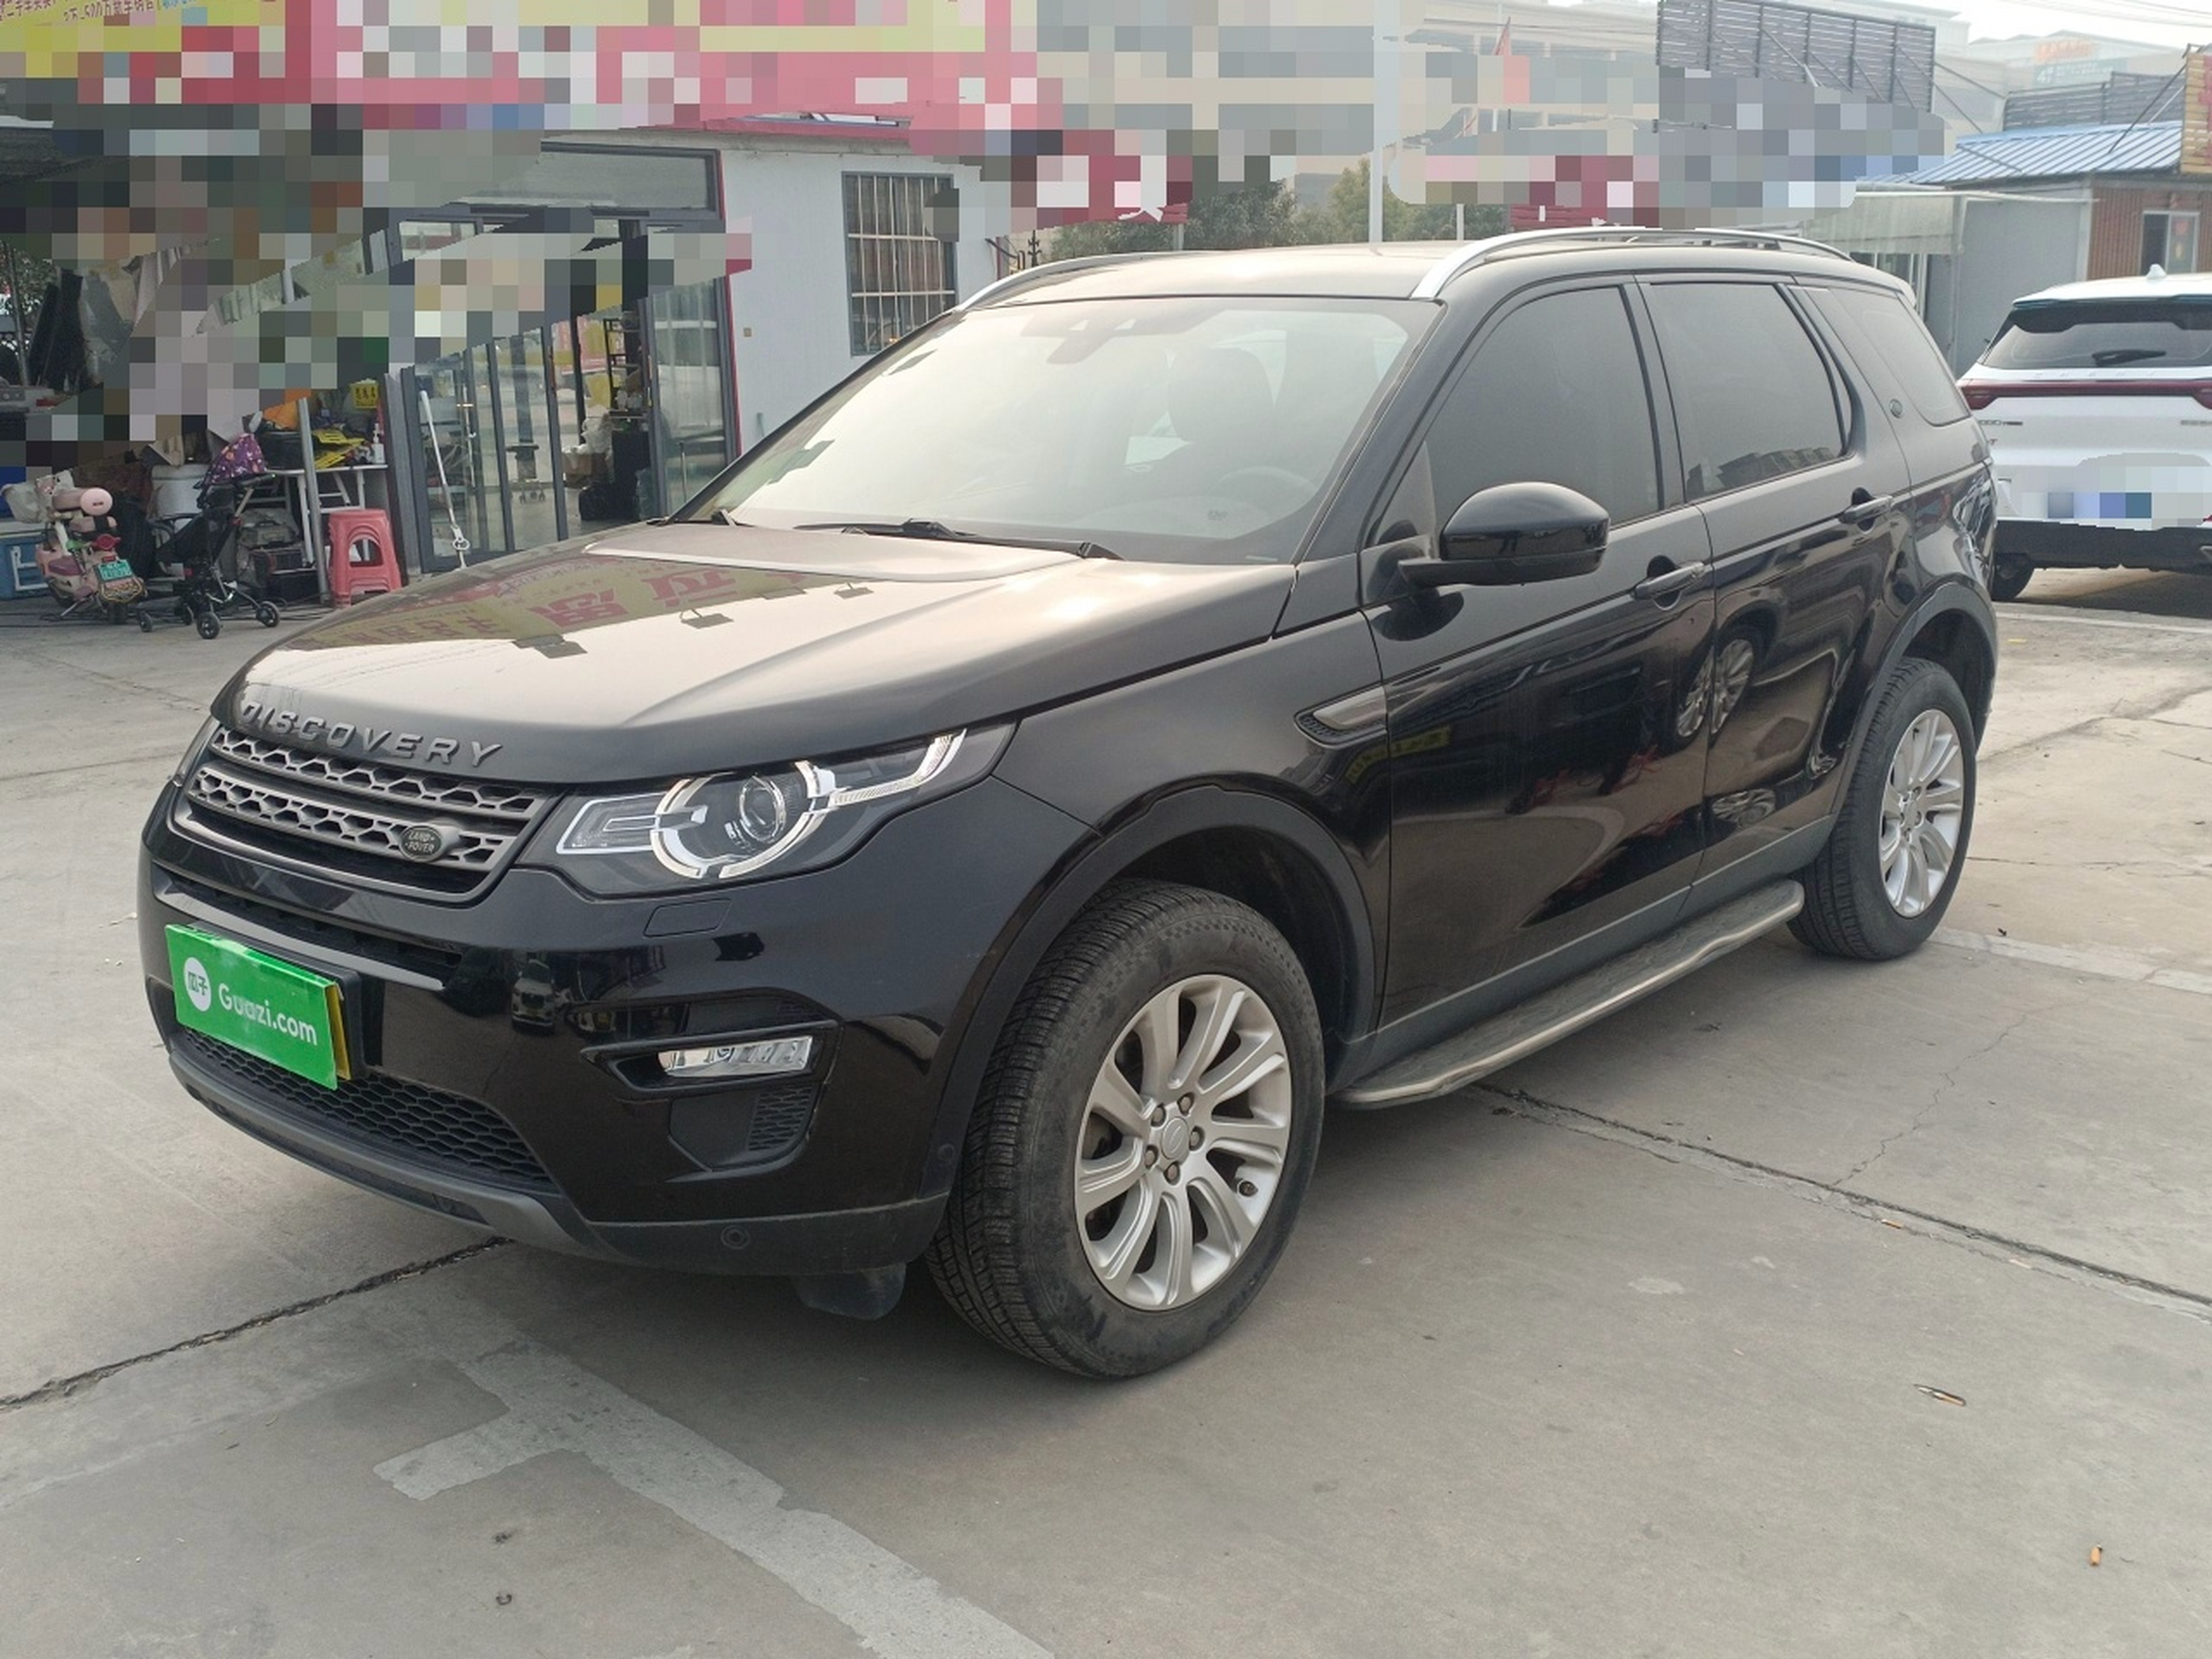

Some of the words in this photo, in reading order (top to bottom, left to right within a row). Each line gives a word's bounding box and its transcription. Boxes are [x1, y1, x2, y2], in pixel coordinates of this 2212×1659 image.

[240, 700, 503, 767] DISCOVERY
[407, 841, 434, 853] ROVER
[408, 831, 431, 842] LAND
[188, 971, 208, 996] 瓜子
[218, 983, 317, 1046] Guazi.com
